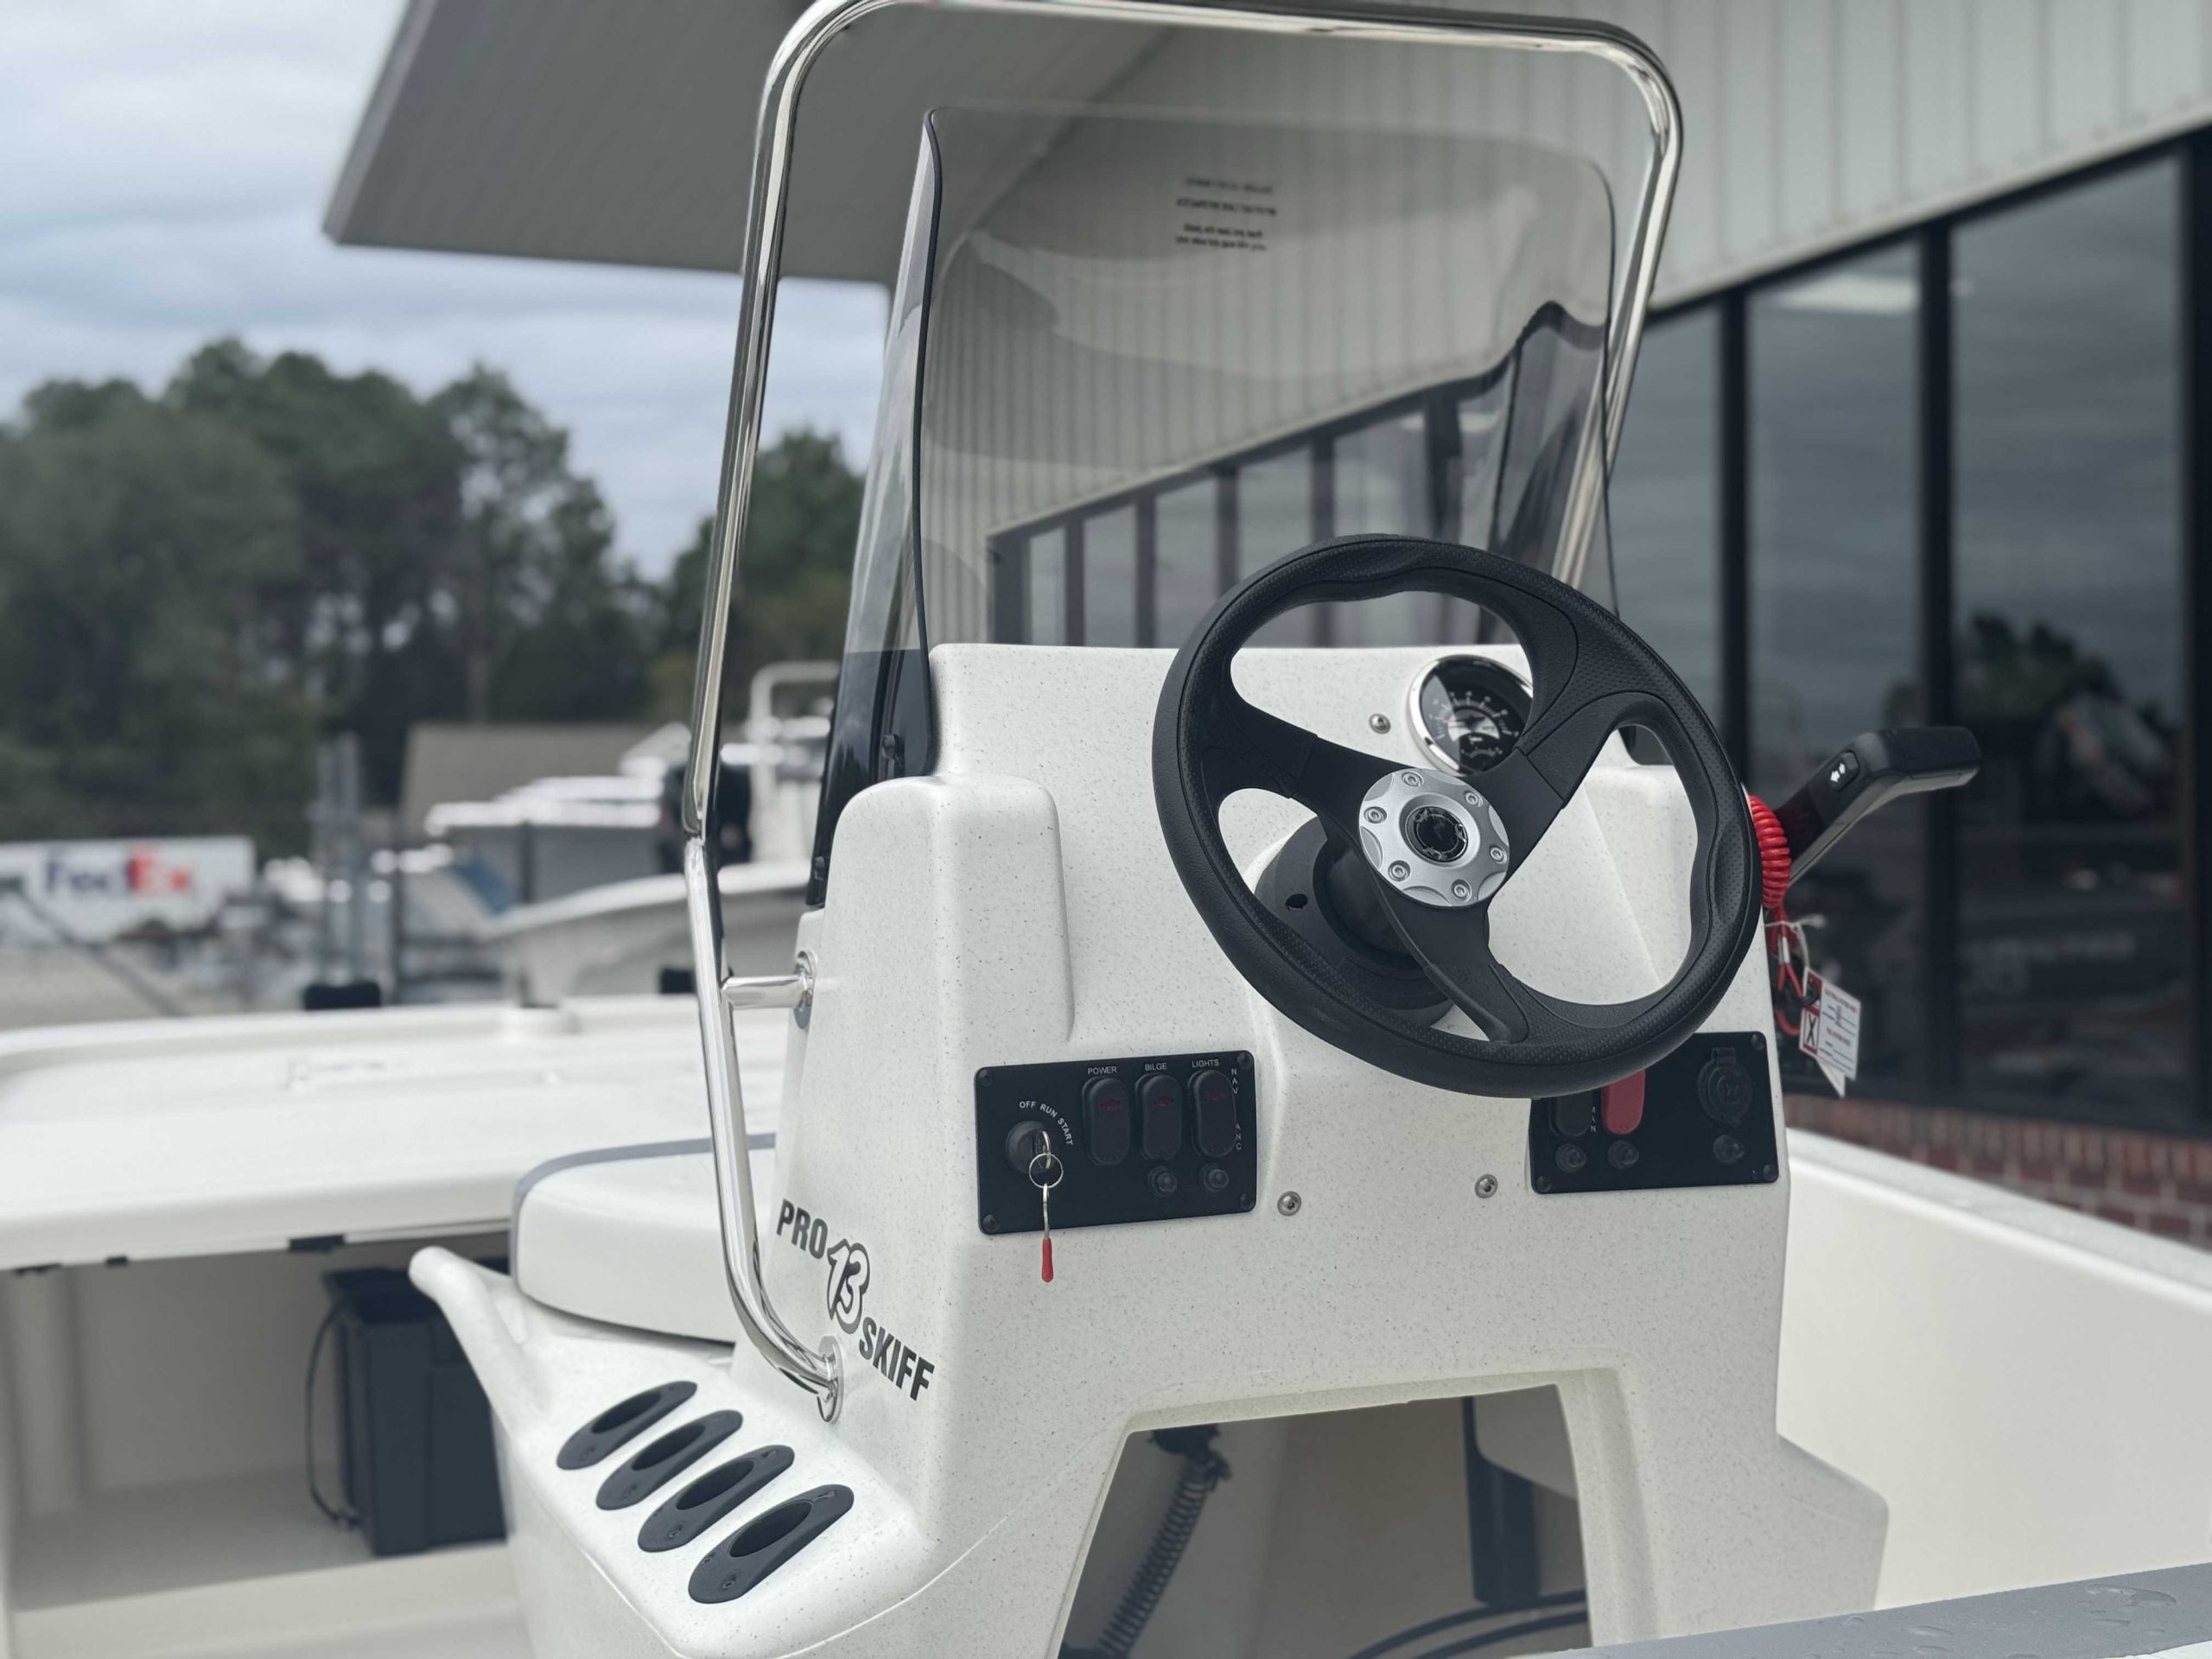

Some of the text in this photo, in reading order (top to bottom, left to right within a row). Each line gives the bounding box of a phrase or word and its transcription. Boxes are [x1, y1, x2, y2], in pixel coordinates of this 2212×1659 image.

[1087, 1065, 1118, 1076] POWER
[1144, 1062, 1168, 1071] BILGE
[1191, 1058, 1220, 1068] LIGHTS
[1230, 1067, 1239, 1095] NAV
[1019, 1100, 1073, 1146] OFF RUN START
[776, 1198, 829, 1260] PRO
[859, 1316, 935, 1401] SKIFF
